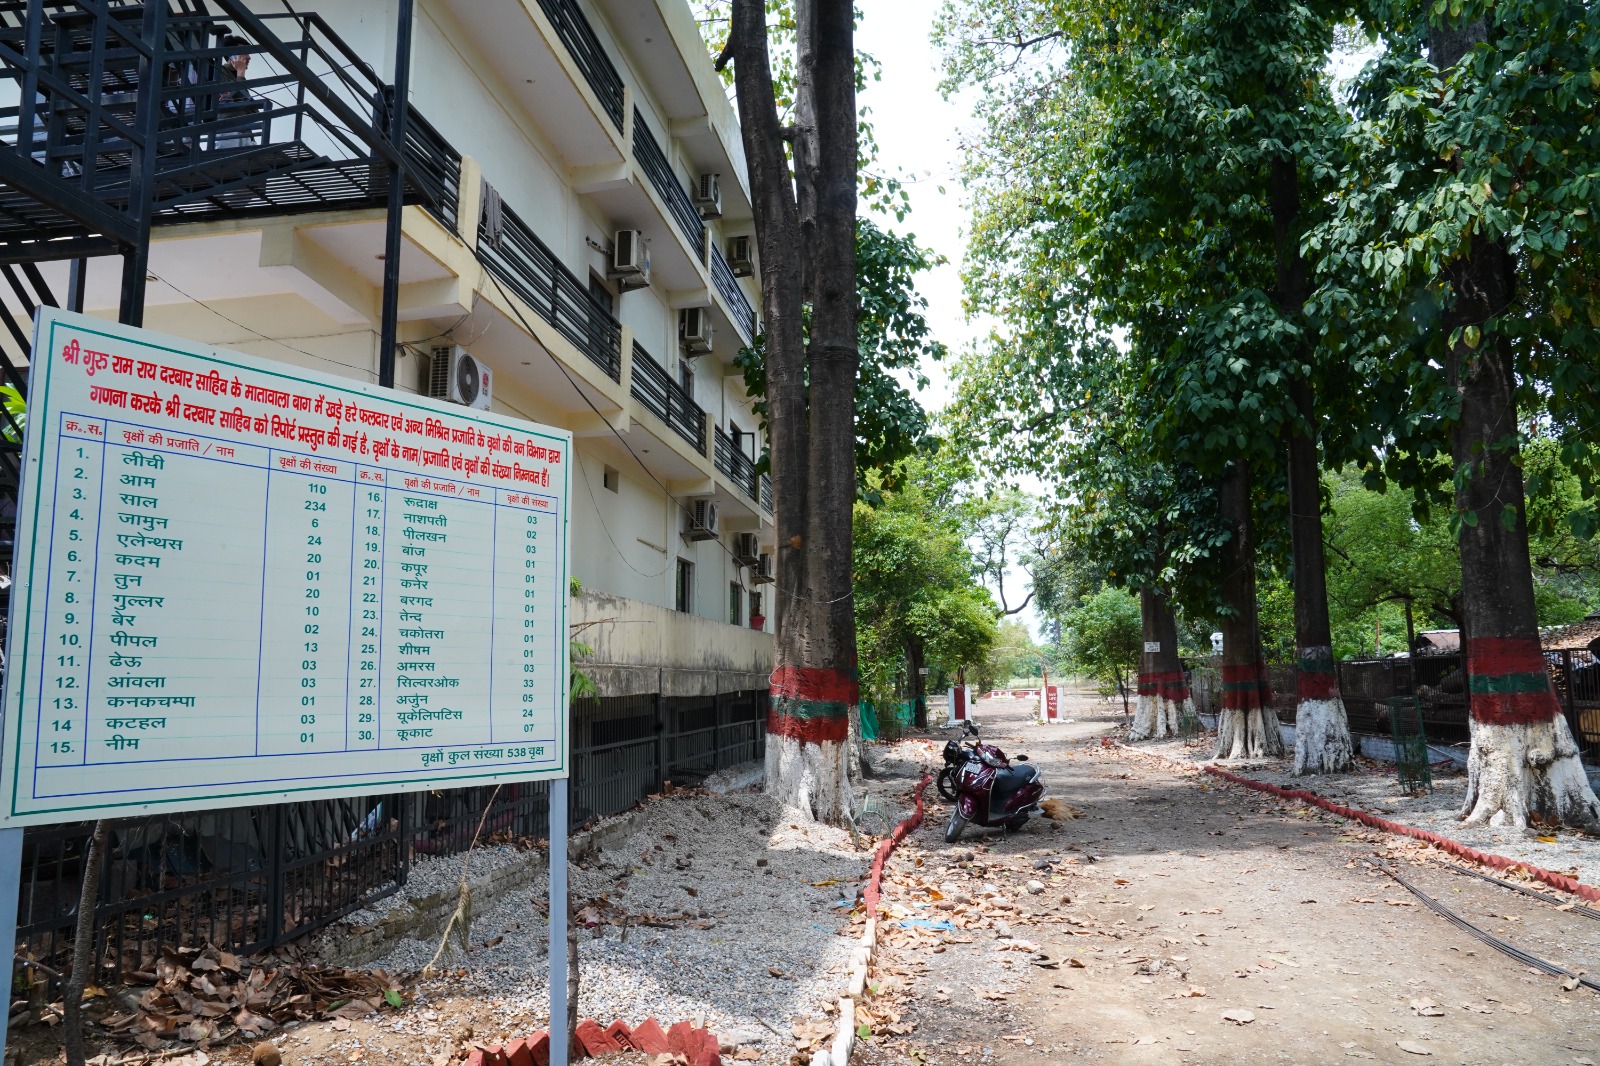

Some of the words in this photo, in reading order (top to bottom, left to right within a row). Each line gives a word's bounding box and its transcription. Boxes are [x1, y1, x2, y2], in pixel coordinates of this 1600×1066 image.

[62, 339, 80, 365] श्री
[83, 349, 109, 376] गुरु
[112, 355, 134, 375] राम
[137, 361, 158, 380] राय
[160, 366, 194, 388] दरबार
[196, 370, 228, 395] साहिब
[231, 376, 243, 398] के
[245, 384, 290, 408] मातावाला
[292, 395, 312, 413] बाग
[314, 394, 325, 414] में
[325, 398, 343, 425] खड़े
[345, 401, 358, 422] हरे
[359, 409, 390, 429] फलदार
[391, 412, 403, 431] एवं
[404, 419, 423, 435] अन्य
[425, 417, 450, 441] मिश्रित
[452, 426, 476, 446] प्रजाति
[477, 429, 485, 447] के
[502, 435, 512, 453] की
[514, 442, 525, 456] वन
[526, 439, 547, 460] विभाग
[548, 449, 561, 463] द्वारा
[90, 385, 128, 408] गणना
[130, 391, 163, 414] करके
[165, 394, 181, 418] श्री
[183, 403, 216, 425] दरबार
[219, 407, 252, 432] साहिब
[254, 413, 269, 435] को
[271, 415, 296, 440] रिपोर्ट
[298, 426, 325, 451] प्रस्तुत
[327, 426, 341, 448] की
[342, 431, 358, 453] गई
[373, 438, 390, 462] वृक्षों
[391, 439, 400, 458] के
[452, 452, 463, 471] एवं
[464, 456, 479, 479] वृक्षों
[480, 457, 490, 476] की
[492, 460, 512, 479] संख्या
[513, 462, 540, 484] निम्नवत
[123, 430, 145, 444] वृक्षों
[148, 433, 163, 445] की
[166, 438, 200, 451] प्रजाति
[216, 446, 234, 457] नाम
[76, 448, 89, 459] 1.
[122, 451, 165, 470] लीची
[280, 456, 297, 469] वृक्षों
[299, 458, 311, 470] की
[313, 461, 337, 474] संख्या
[74, 468, 87, 479] 2.
[120, 474, 156, 488] आम
[308, 483, 326, 494] 110
[404, 477, 418, 489] वृक्षों
[421, 479, 431, 489] की
[433, 483, 456, 493] प्रजाति
[467, 488, 480, 497] नाम
[73, 488, 86, 500] 3.
[368, 492, 382, 502] 16.
[119, 493, 158, 508] साल
[507, 494, 519, 504] वृक्षों
[521, 495, 530, 505] की
[532, 497, 548, 508] संख्या
[305, 500, 326, 512] 234
[70, 509, 83, 520] 4.
[367, 509, 380, 519] 17.
[118, 513, 168, 531] जामुन
[312, 518, 318, 528] 6
[403, 514, 447, 527] नाशपती
[527, 516, 537, 524] 03
[69, 530, 82, 541] 5.
[366, 526, 380, 536] 18.
[403, 527, 447, 543] पीलखन
[527, 530, 536, 539] 02
[116, 532, 183, 550] एलेन्थस
[308, 536, 322, 545] 24
[365, 542, 380, 552] 19.
[402, 543, 425, 557] बांज
[526, 545, 536, 554] 03
[68, 551, 81, 562] 6.
[115, 554, 161, 568] कदम
[307, 554, 321, 563] 20
[364, 559, 379, 569] 20.
[526, 560, 535, 568] 01
[401, 563, 428, 577] कपूर
[67, 571, 80, 582] 7.
[307, 571, 319, 581] 01
[363, 576, 375, 585] 21
[525, 575, 534, 583] 01
[114, 574, 142, 590] तुन
[400, 577, 428, 589] कनेर
[65, 592, 79, 603] 8.
[306, 588, 320, 598] 20
[363, 593, 378, 603] 22.
[525, 590, 534, 598] 01
[112, 595, 165, 610] गुल्लर
[400, 596, 433, 607] बरगद
[306, 606, 319, 616] 10
[525, 605, 534, 613] 01
[65, 613, 79, 624] 9.
[111, 610, 136, 626] बेर
[363, 610, 378, 619] 23.
[305, 624, 319, 634] 02
[525, 620, 534, 628] 01
[362, 627, 377, 636] 24.
[399, 626, 444, 639] चकोतरा
[60, 634, 81, 648] 10.
[109, 631, 158, 647] पीपल
[304, 642, 318, 652] 13
[361, 644, 377, 653] 25.
[398, 642, 430, 655] शीषम
[58, 656, 80, 666] 11.
[302, 660, 316, 670] 03
[361, 661, 376, 670] 26.
[524, 664, 534, 672] 03
[56, 677, 79, 688] 12.
[302, 678, 316, 688] 03
[360, 678, 376, 687] 27.
[524, 679, 533, 687] 33
[106, 697, 196, 707] कनकचम्पा
[302, 696, 314, 706] 01
[360, 696, 375, 705] 28.
[523, 694, 533, 702] 05
[53, 698, 77, 709] 13.
[359, 713, 375, 722] 29.
[523, 709, 533, 717] 24
[105, 718, 167, 730] कटहल
[301, 715, 315, 724] 03
[52, 720, 71, 731] 14
[524, 724, 534, 732] 07
[300, 733, 314, 742] 01
[359, 731, 374, 740] 30.
[51, 741, 74, 753] 15.
[104, 734, 140, 750] नीम
[421, 748, 444, 767] वृक्षों
[448, 751, 470, 764] कुल
[473, 746, 504, 759] संख्या
[508, 748, 526, 757] 538
[528, 747, 544, 759] वृक्ष
